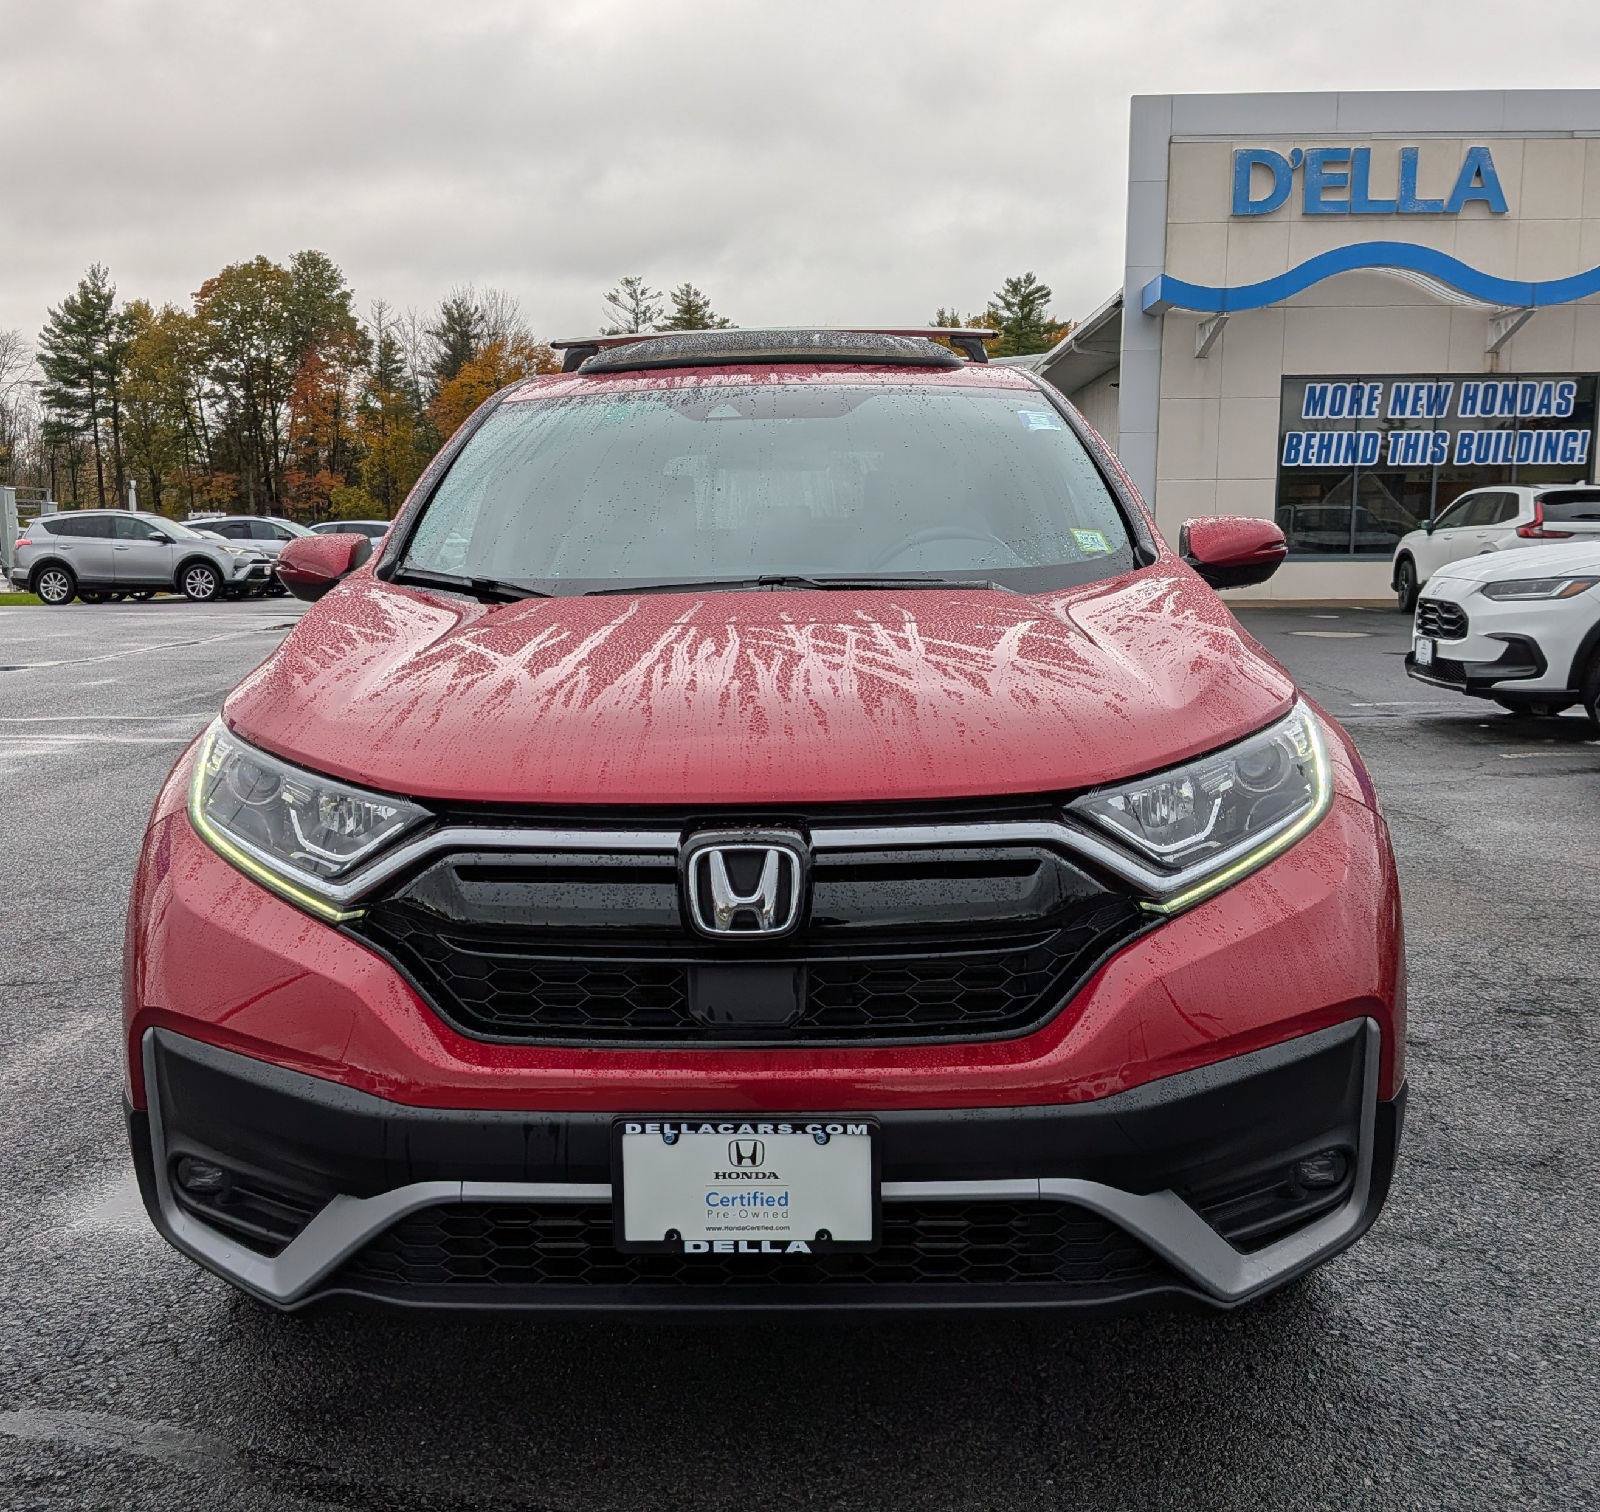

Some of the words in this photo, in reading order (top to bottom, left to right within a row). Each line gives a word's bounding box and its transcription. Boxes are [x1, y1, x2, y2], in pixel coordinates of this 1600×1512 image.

[1232, 146, 1509, 216] D'ELLA
[1302, 382, 1383, 419] MORE
[1388, 382, 1454, 418] NEW
[1458, 381, 1577, 418] HONDAS
[1282, 431, 1382, 466] BEHIND
[1387, 431, 1450, 466] THIS
[1454, 430, 1591, 465] BUILDING!
[625, 1123, 868, 1135] DELLACARS.COM
[713, 1171, 781, 1180] HONDA
[705, 1191, 789, 1207] Certified
[706, 1209, 789, 1219] Pre-Owned
[684, 1240, 812, 1254] DELLA
